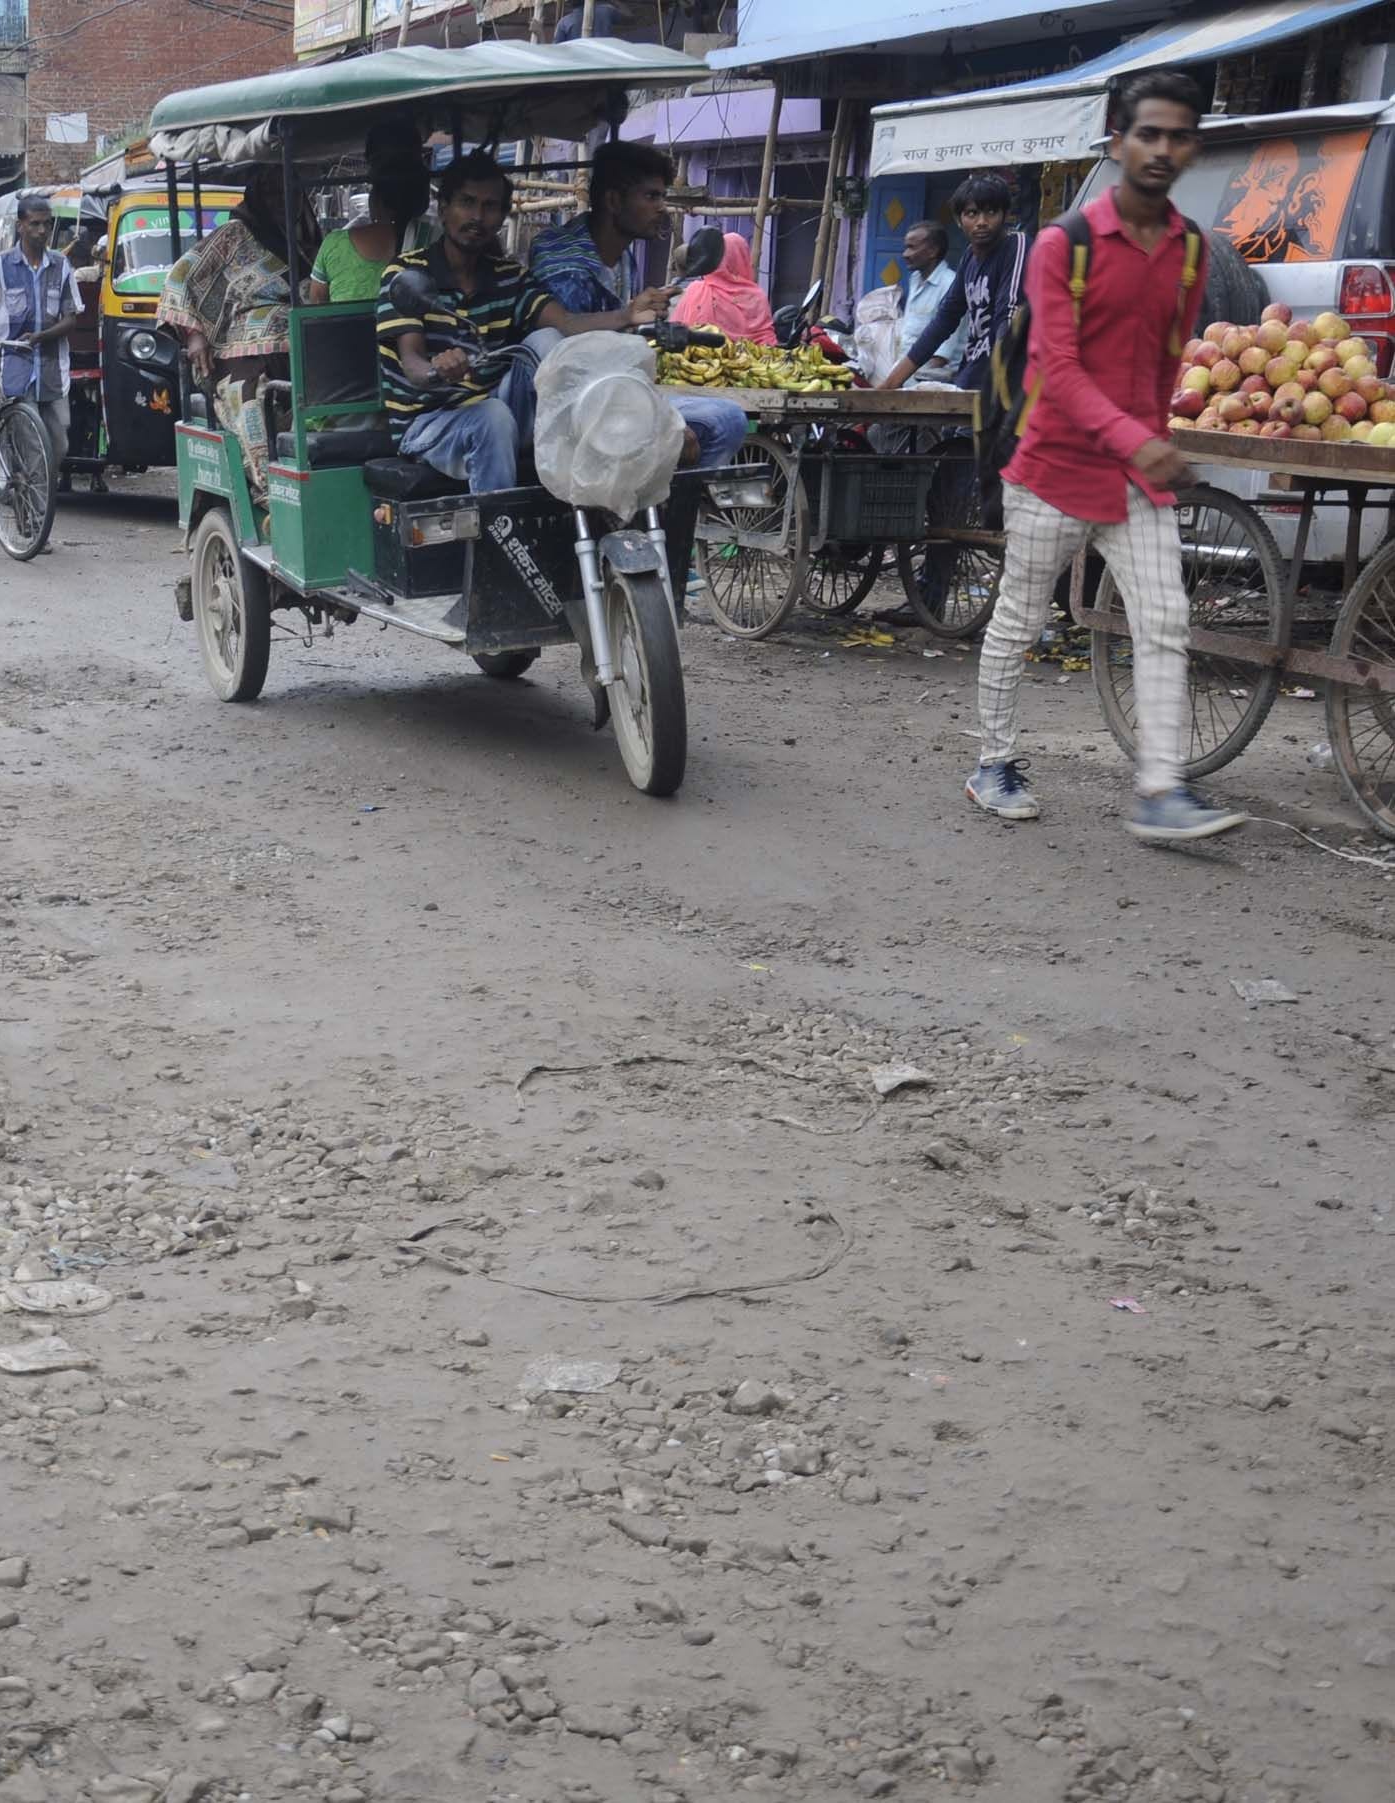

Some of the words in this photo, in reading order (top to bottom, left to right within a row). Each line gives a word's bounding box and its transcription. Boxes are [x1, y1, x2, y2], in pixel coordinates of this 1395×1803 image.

[902, 149, 930, 161] राज
[935, 143, 973, 161] कुमार
[981, 139, 1015, 155] रजत
[1022, 135, 1066, 152] कुमार
